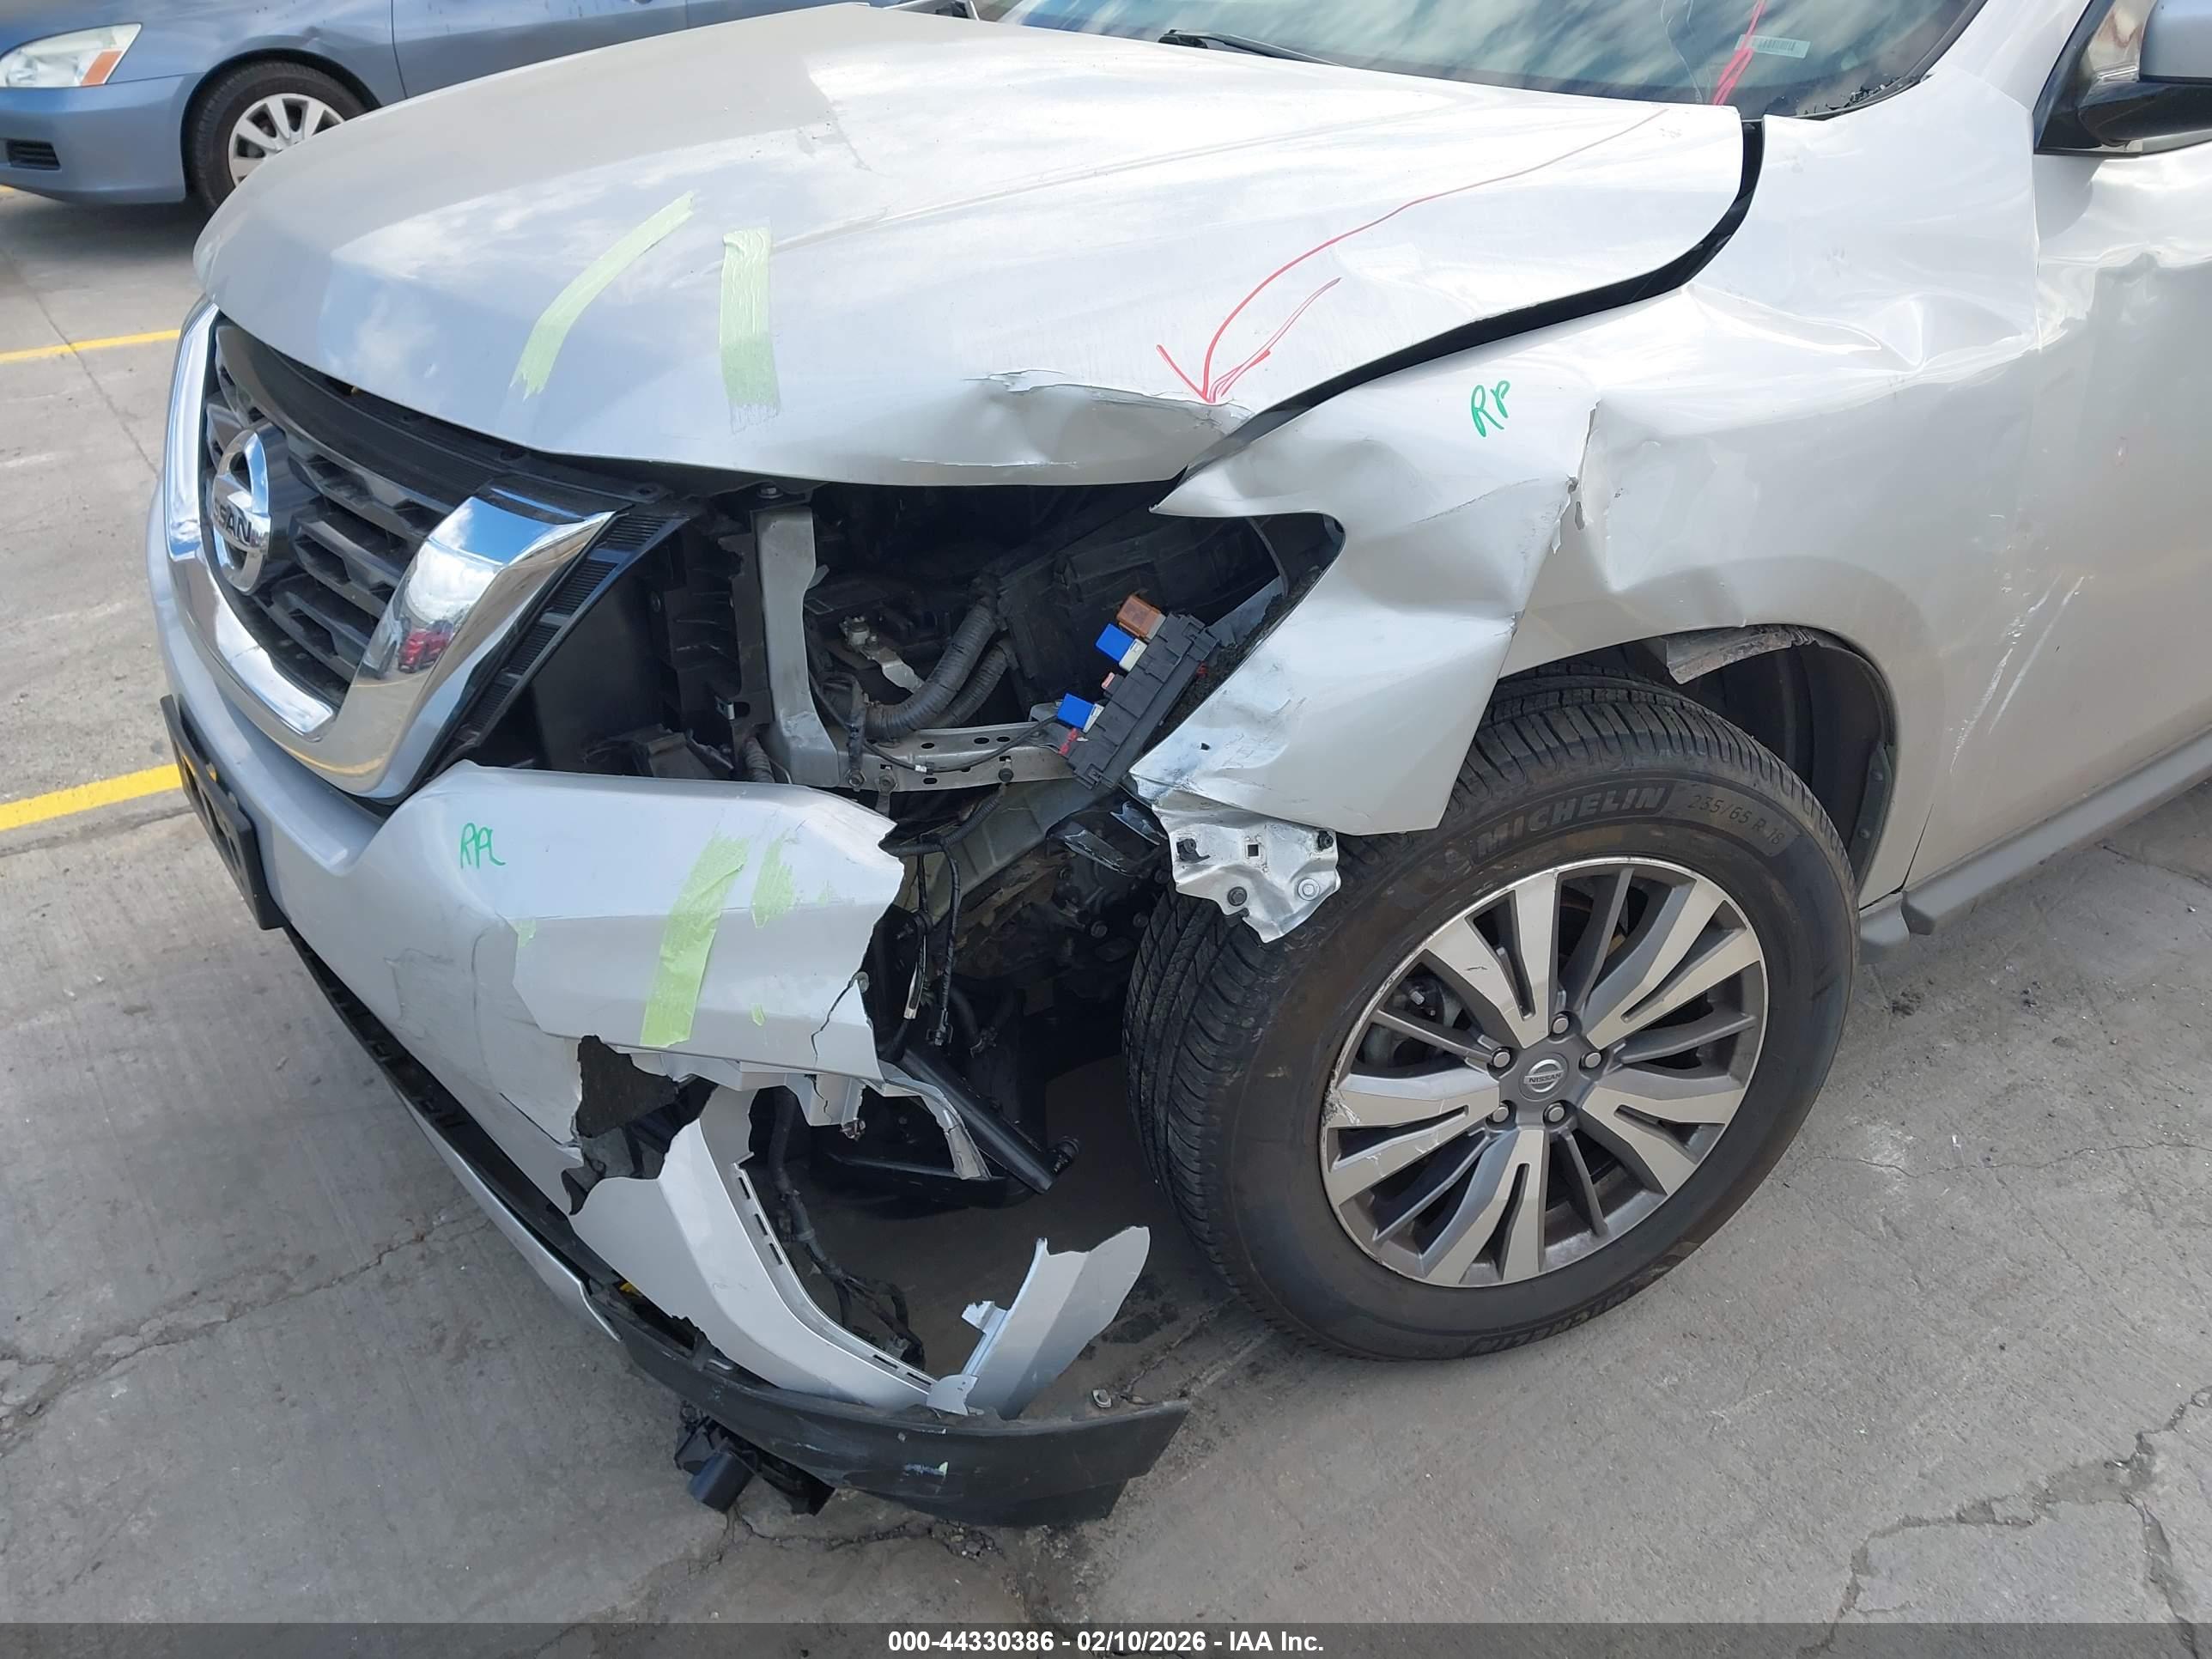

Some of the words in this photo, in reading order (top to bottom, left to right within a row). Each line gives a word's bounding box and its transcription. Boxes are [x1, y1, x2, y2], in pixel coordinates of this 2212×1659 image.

[1476, 786, 1664, 858] MICHELIN
[1687, 793, 1753, 824] 235/65
[1751, 817, 1767, 832] R
[1767, 827, 1786, 846] 18
[1528, 1073, 1561, 1083] NISSAN
